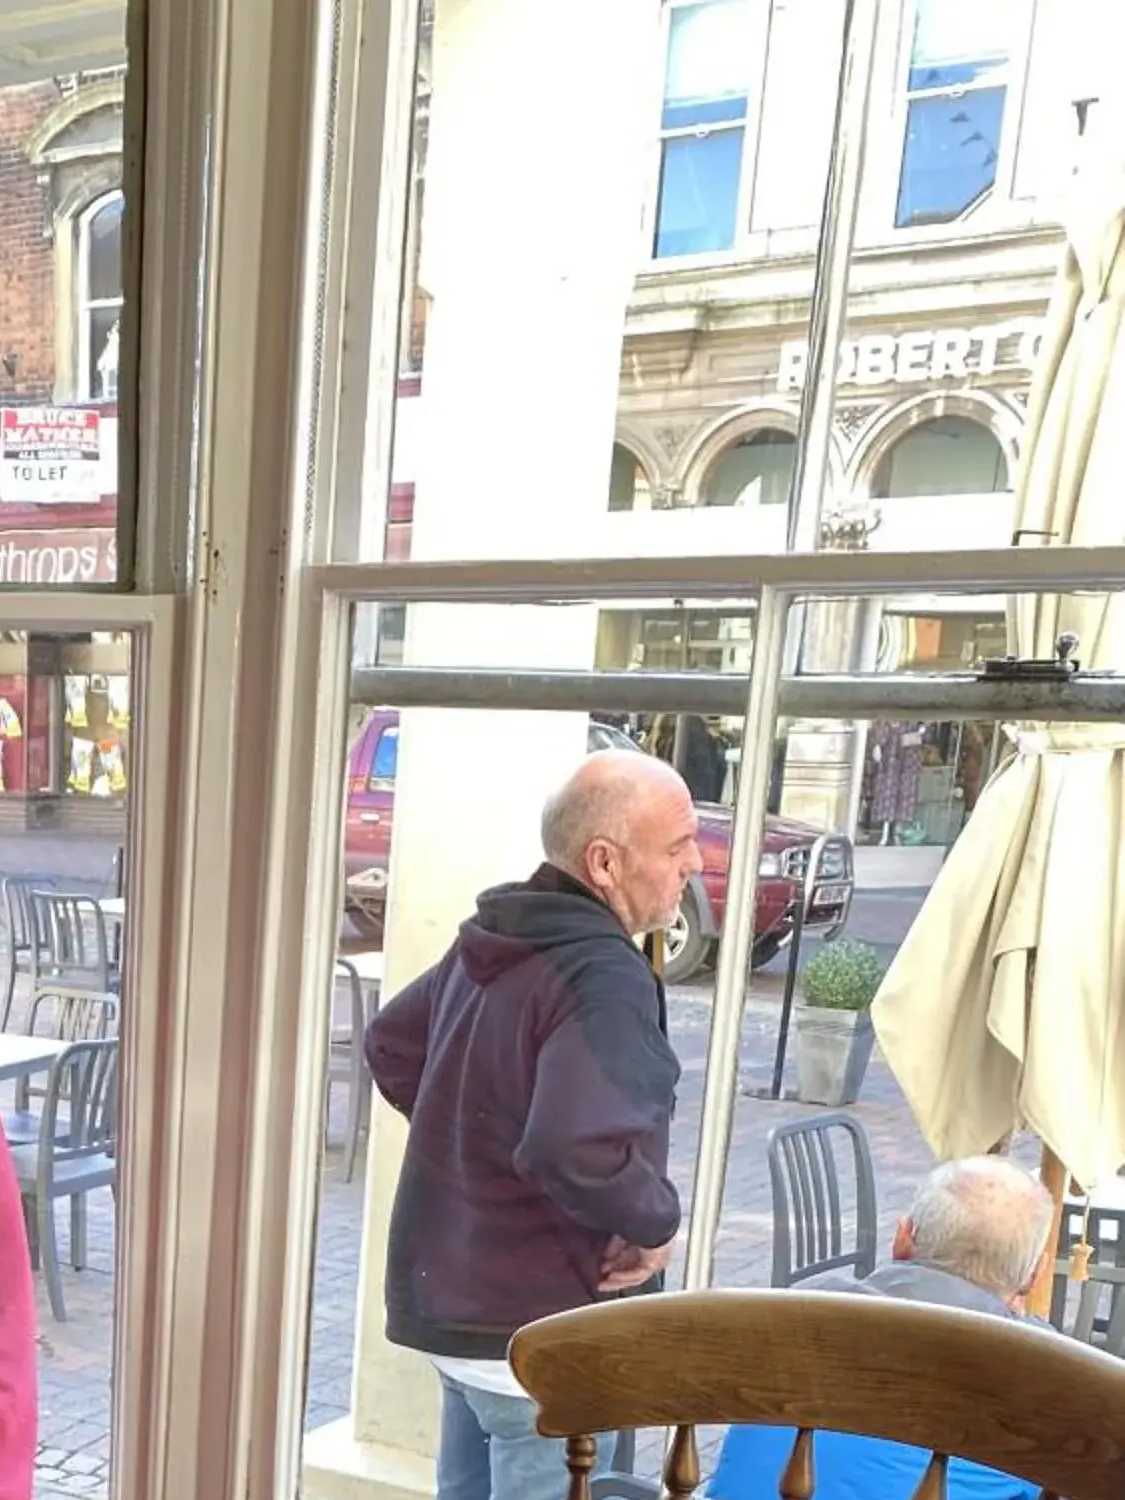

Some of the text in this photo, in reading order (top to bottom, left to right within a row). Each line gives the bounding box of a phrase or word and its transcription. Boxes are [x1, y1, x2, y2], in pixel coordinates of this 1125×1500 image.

[777, 326, 997, 391] RBERT
[12, 465, 67, 480] TO LET
